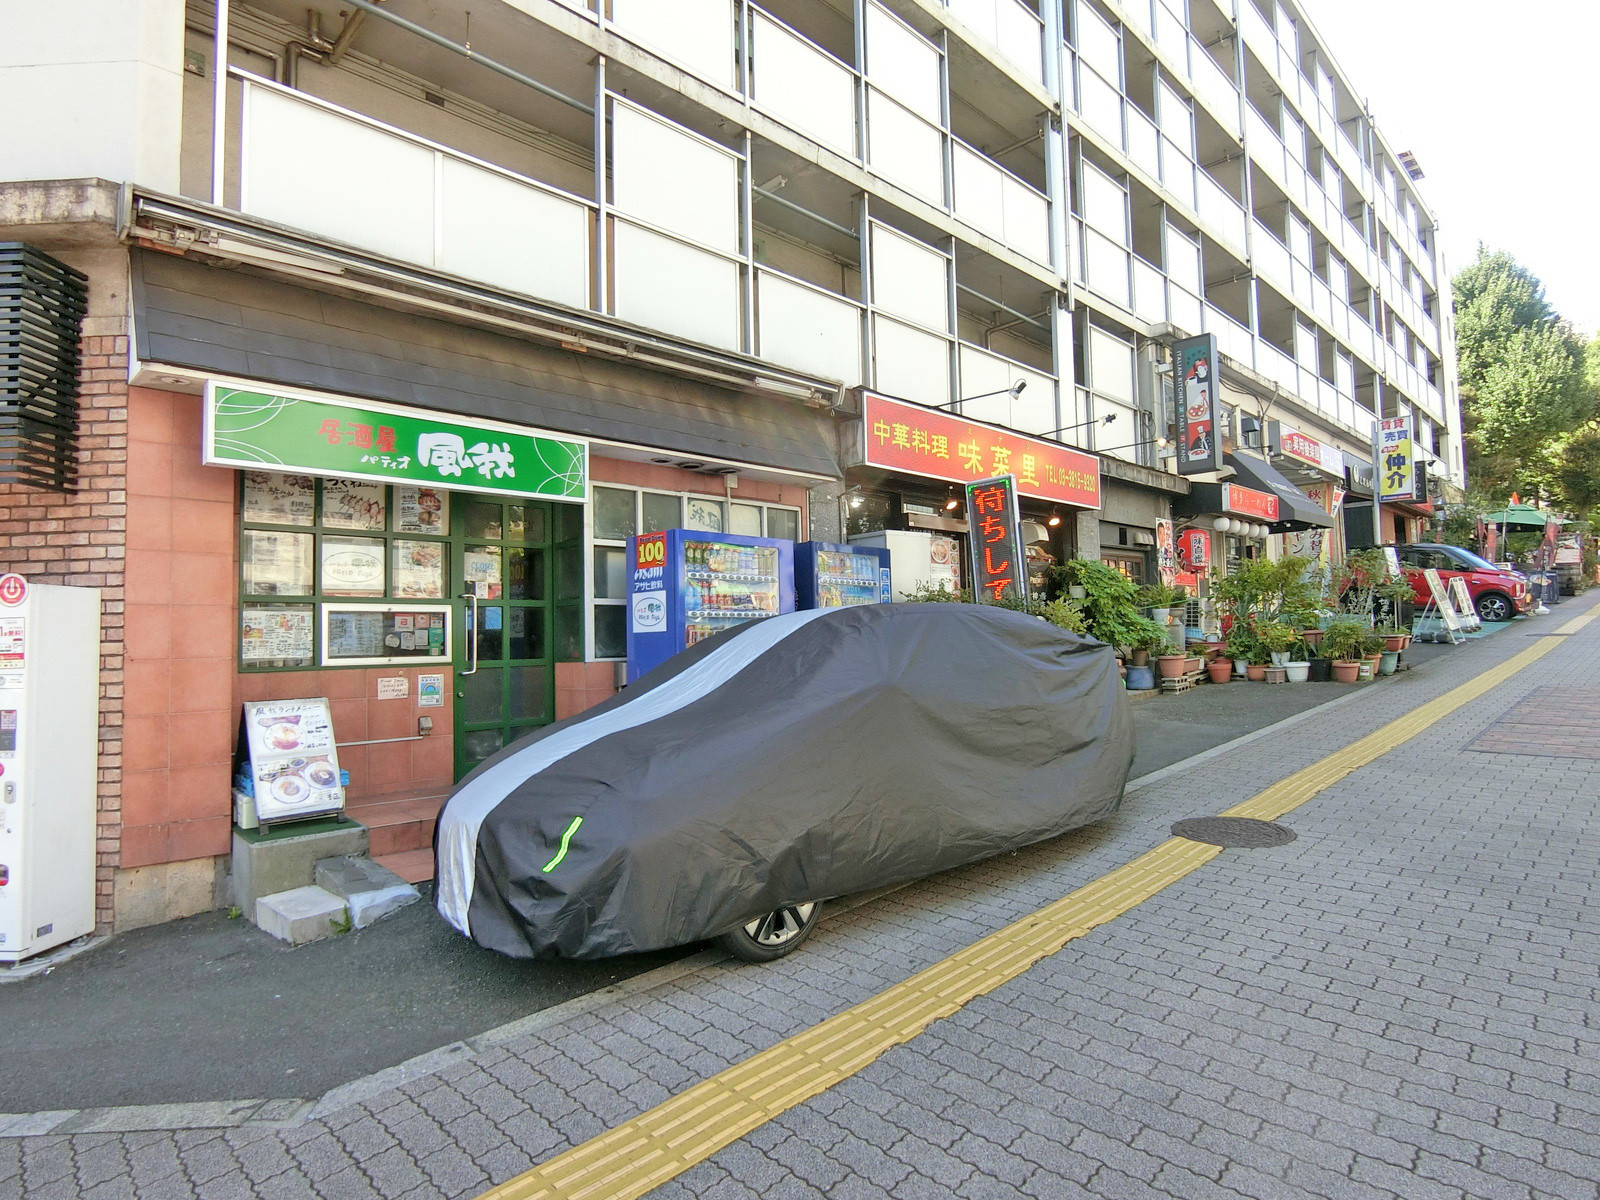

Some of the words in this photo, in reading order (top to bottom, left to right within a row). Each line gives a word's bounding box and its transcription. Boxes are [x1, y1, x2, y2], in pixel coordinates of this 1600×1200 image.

[1380, 418, 1404, 430] 賃貸
[317, 419, 399, 453] 居酒屋
[1384, 430, 1409, 442] 売買
[360, 453, 411, 470] パティオ
[873, 419, 950, 460] 中華料理
[958, 438, 1040, 488] 味菜里
[1045, 464, 1058, 484] TEL
[1386, 453, 1406, 489] 仲介
[1308, 489, 1321, 500] 秋
[638, 541, 664, 563] 100
[974, 486, 1012, 600] 待ちして
[634, 581, 664, 591] アサヒ飲料
